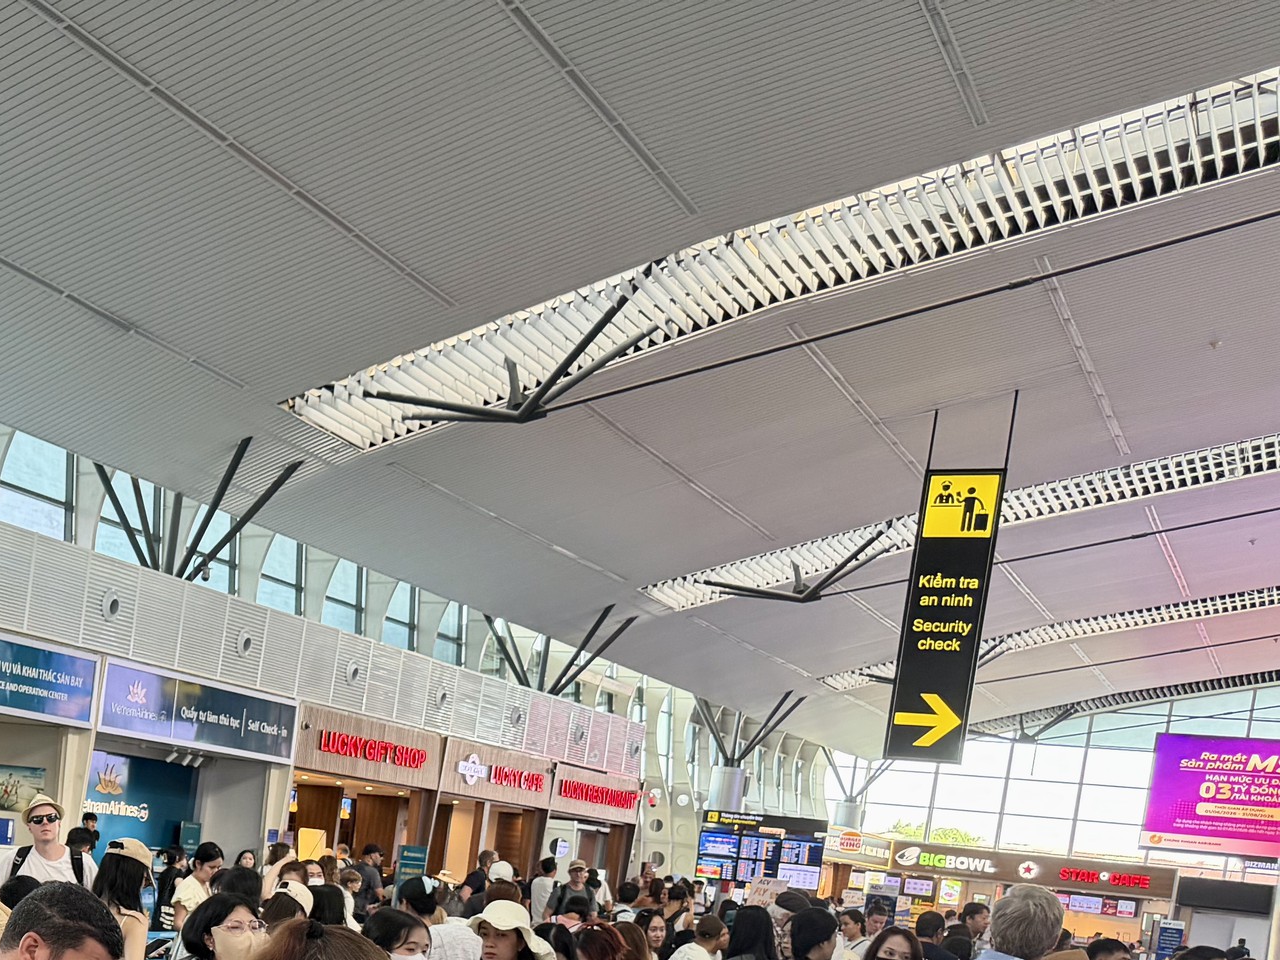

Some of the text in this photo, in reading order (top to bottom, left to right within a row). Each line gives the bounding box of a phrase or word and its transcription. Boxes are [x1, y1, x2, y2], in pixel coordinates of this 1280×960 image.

[918, 573, 979, 589] Kiểm tra
[920, 594, 973, 607] an ninh
[912, 619, 972, 637] Security
[917, 638, 960, 652] check
[1, 663, 12, 676] VỤ
[12, 663, 21, 675] VÀ
[21, 667, 38, 679] KHAI
[39, 667, 57, 683] THÁC
[70, 676, 83, 688] BAY
[5, 682, 18, 691] AND
[18, 684, 48, 697] OPERATION
[48, 690, 69, 701] CENTER
[248, 719, 288, 738] Self Check in
[321, 729, 427, 769] LUCKY GIFT SHOP
[1200, 752, 1218, 760] Ra
[1180, 758, 1204, 768] Sản
[1246, 754, 1280, 773] M
[490, 764, 520, 790] LUCKY
[520, 771, 545, 793] CAFE
[1205, 774, 1228, 783] HẠN
[1230, 774, 1253, 783] MỨC
[561, 779, 637, 811] LUCKY RESTAURANT
[1199, 781, 1232, 799] 03
[839, 840, 862, 849] KING
[1245, 860, 1278, 870] BIZMAN
[1059, 867, 1151, 889] STAR CAFE
